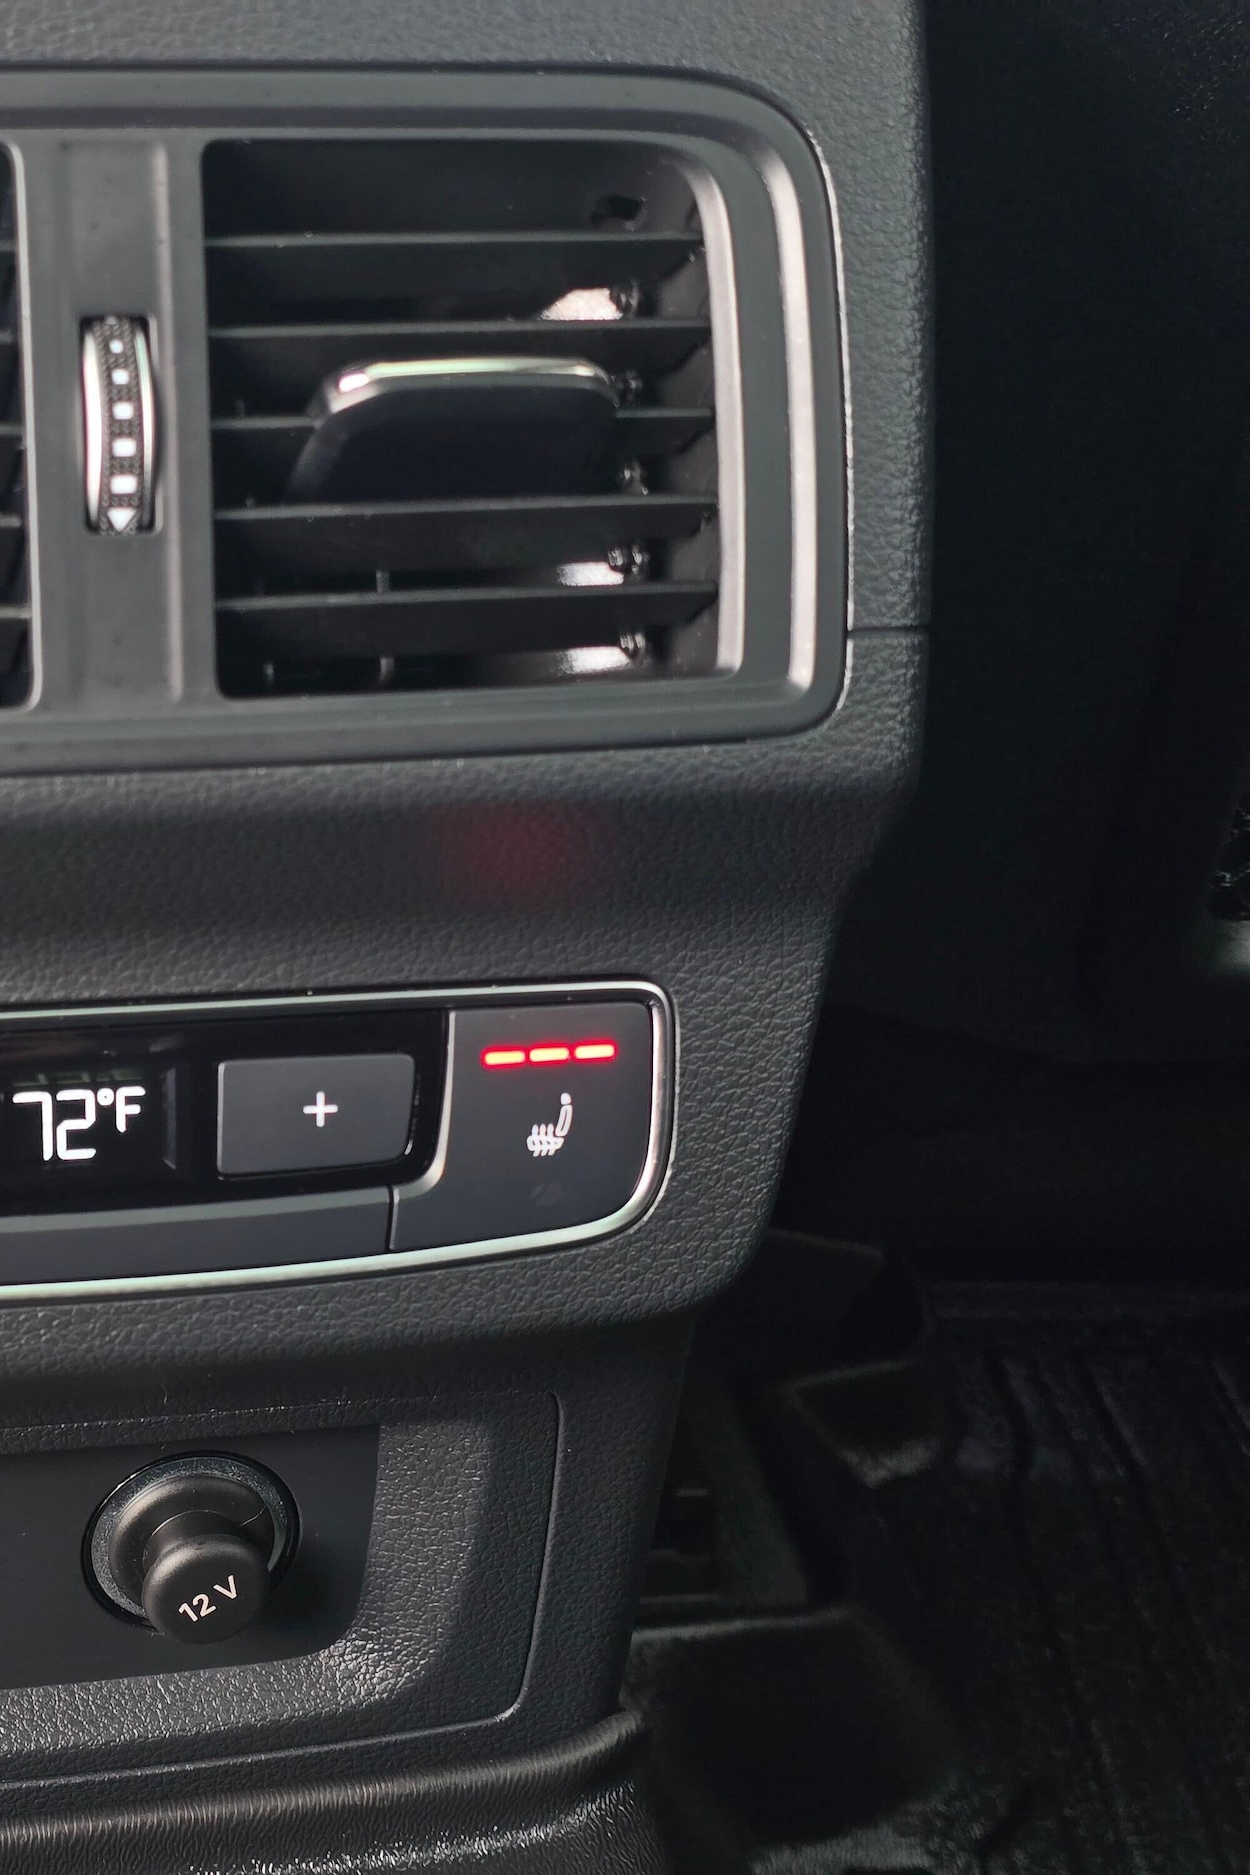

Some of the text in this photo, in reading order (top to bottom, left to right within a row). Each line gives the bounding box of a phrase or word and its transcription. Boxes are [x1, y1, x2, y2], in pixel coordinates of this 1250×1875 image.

[12, 1085, 146, 1162] 72°F
[178, 1574, 239, 1623] 12 V
